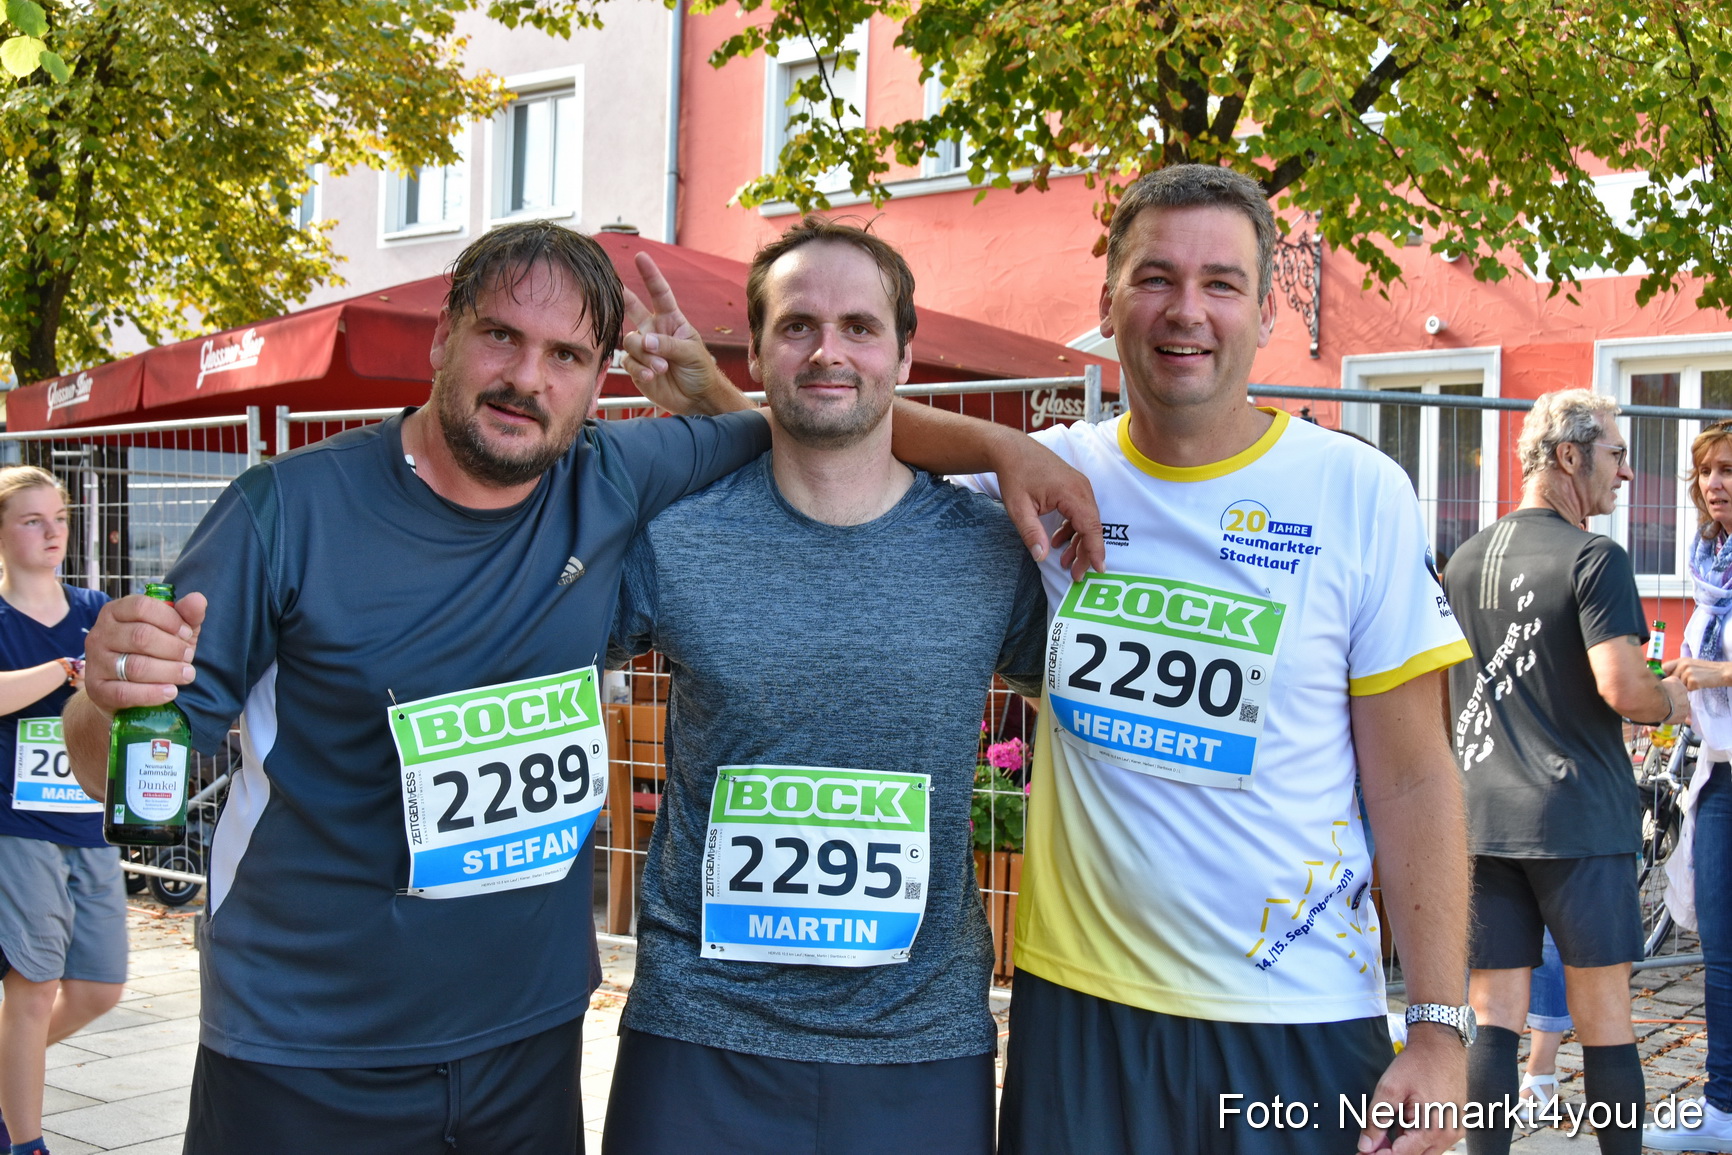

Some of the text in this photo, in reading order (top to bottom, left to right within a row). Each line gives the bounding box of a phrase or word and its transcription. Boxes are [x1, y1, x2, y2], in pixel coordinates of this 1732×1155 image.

[1222, 533, 1322, 556] Neumarkter
[1226, 509, 1309, 535] 20 JAHRE
[1219, 547, 1301, 575] Stadtlauf
[1074, 579, 1267, 645] BOCK
[1067, 632, 1261, 718] 2290 D
[409, 678, 589, 756] BOCK
[1073, 709, 1222, 763] HERBERT
[137, 780, 177, 791] Dunkel
[138, 768, 178, 777] Lammsbräu
[432, 744, 600, 834] 2289 D
[723, 774, 912, 825] BOCK
[462, 826, 579, 875] STEFAN
[729, 835, 919, 899] 2295 C
[749, 914, 878, 944] MARTIN
[1255, 940, 1289, 971] 14./15.
[1336, 868, 1355, 895] 2019
